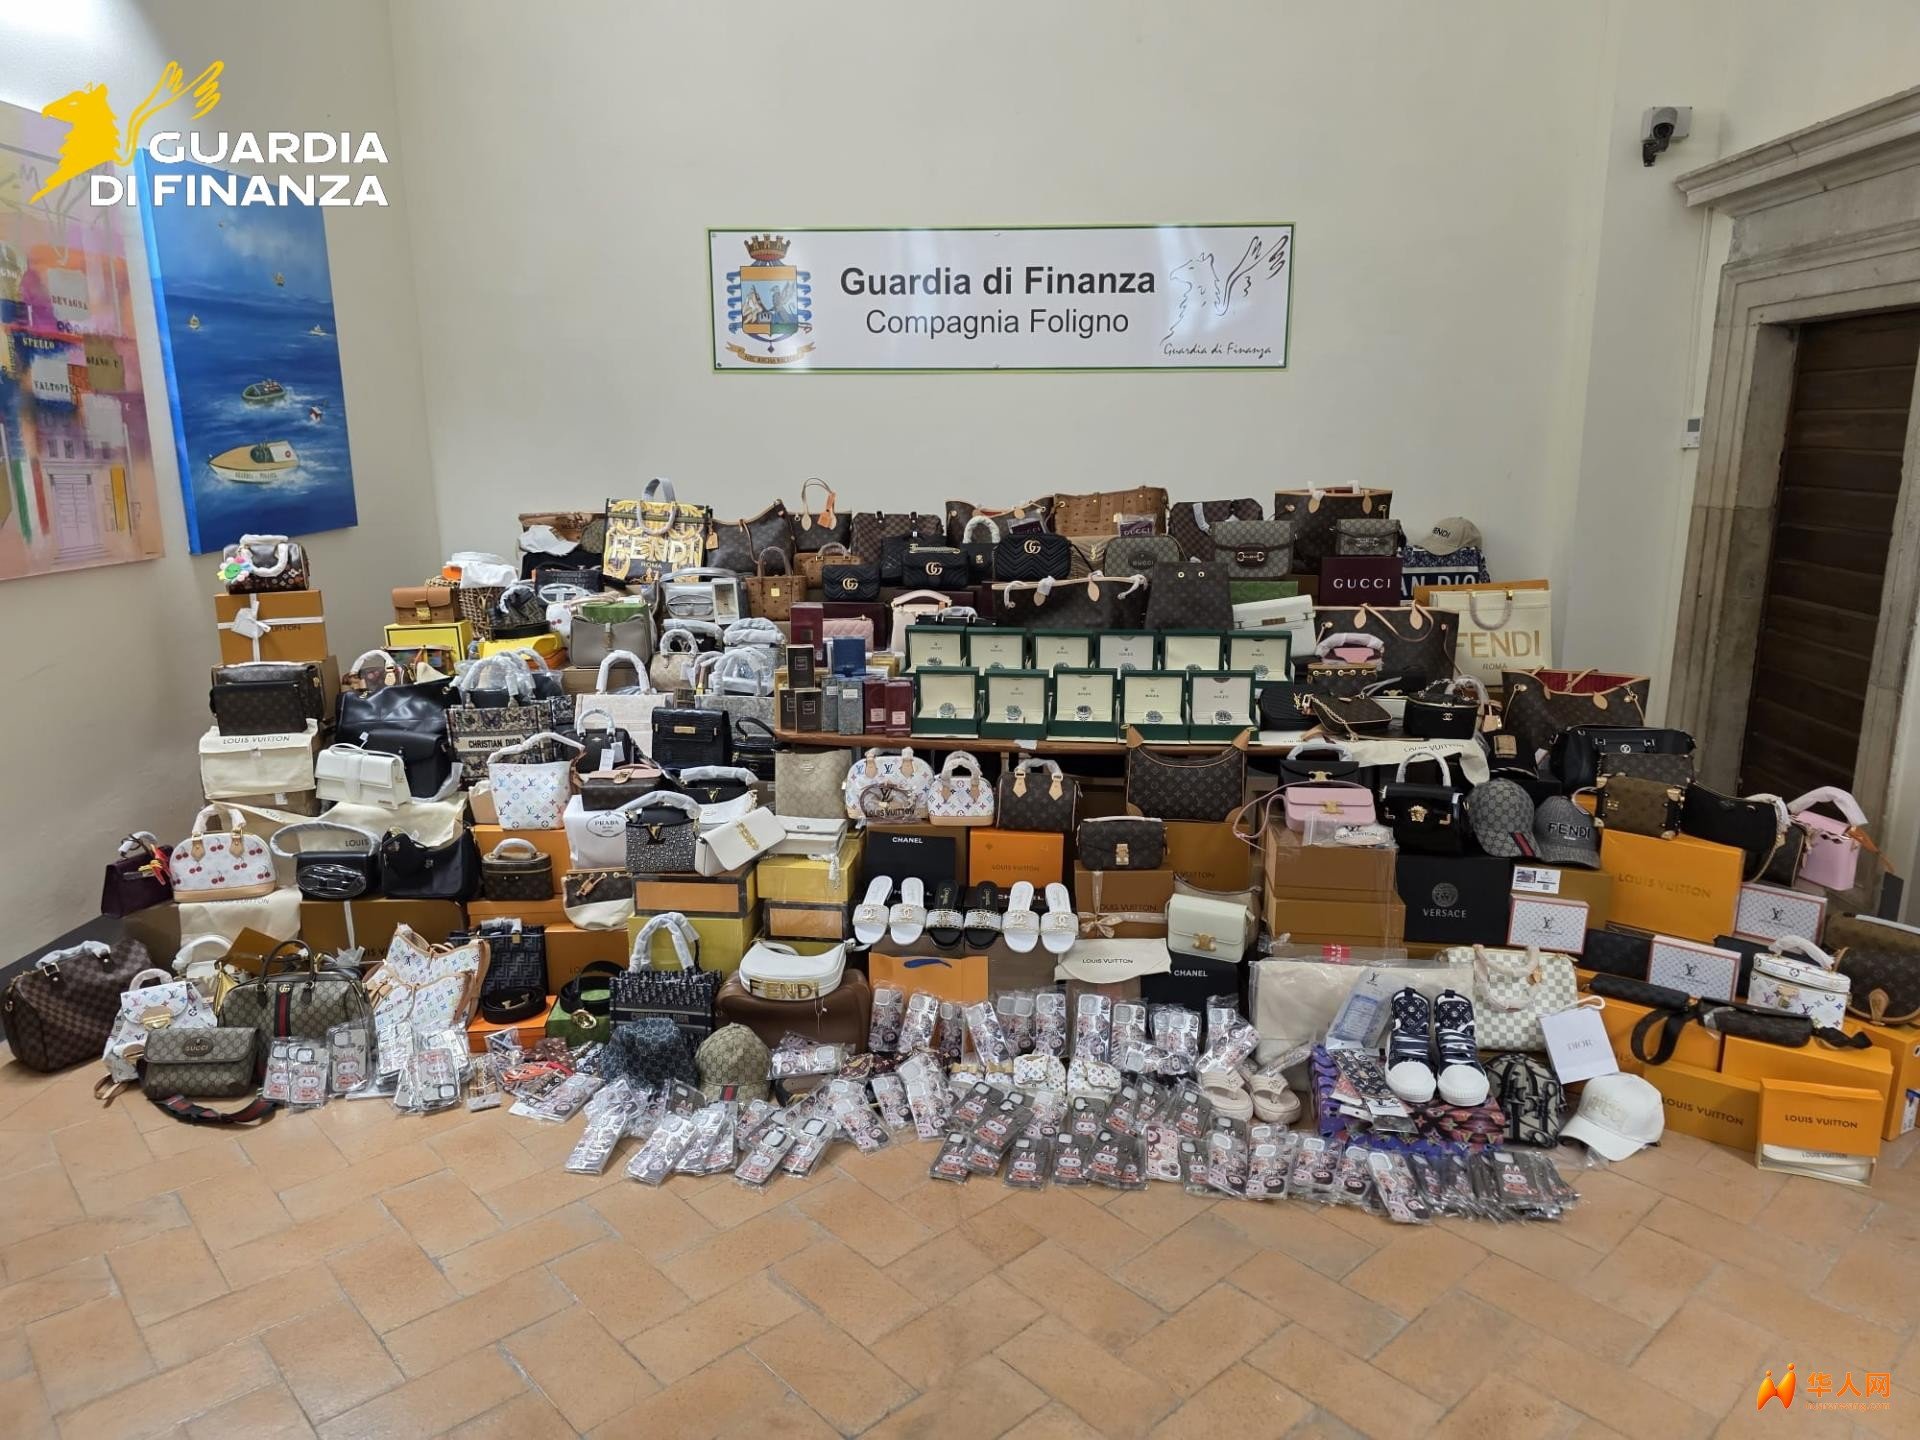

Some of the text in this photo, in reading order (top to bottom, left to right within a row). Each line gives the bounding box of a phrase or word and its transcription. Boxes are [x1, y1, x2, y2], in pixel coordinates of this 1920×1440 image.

[840, 266, 1155, 295] Guardia di Finanza
[866, 309, 1129, 339] Compagnia Foligno
[1164, 342, 1272, 359] Guardia di Finanza
[609, 533, 702, 567] FENDI
[641, 561, 662, 569] ROMA
[1333, 578, 1391, 589] GUCCI
[223, 735, 290, 745] LOUIS VUITTON
[468, 738, 502, 748] CHRISTIAN
[1549, 822, 1591, 838] FENDI
[892, 836, 923, 844] CHANEL
[1618, 873, 1712, 898] LOUIS VUITTON
[1100, 903, 1120, 911] OUIS
[1422, 908, 1467, 918] VERSACE
[1174, 969, 1208, 977] CHANEL
[748, 978, 820, 999] FENDI
[1567, 1039, 1592, 1050] DIOR
[1697, 1106, 1744, 1127] VUITTON
[1785, 1114, 1858, 1129] LOUIS VUITTON
